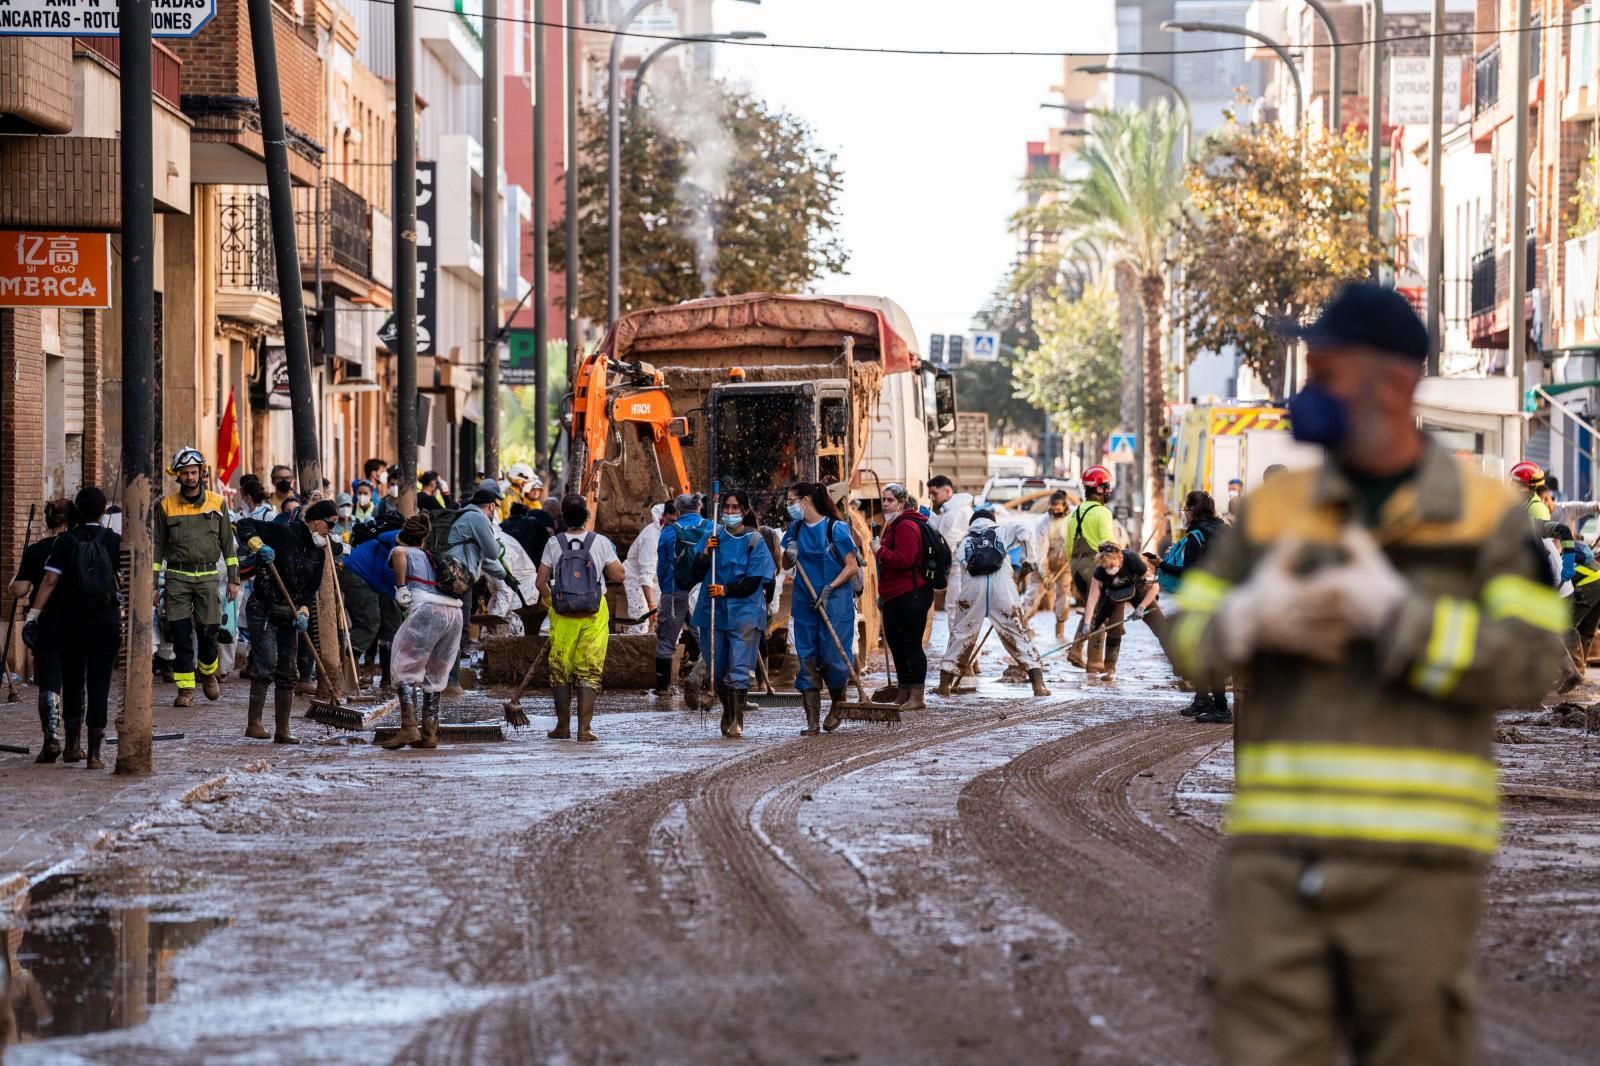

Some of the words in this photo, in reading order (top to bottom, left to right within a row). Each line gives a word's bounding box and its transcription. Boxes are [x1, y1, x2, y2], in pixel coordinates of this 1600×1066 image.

[0, 10, 71, 28] NCARTAS
[83, 11, 192, 30] ROTUIONES
[15, 234, 80, 266] 亿高
[52, 265, 76, 273] GAO
[0, 276, 97, 297] MERCA
[631, 403, 651, 415] HITACHI
